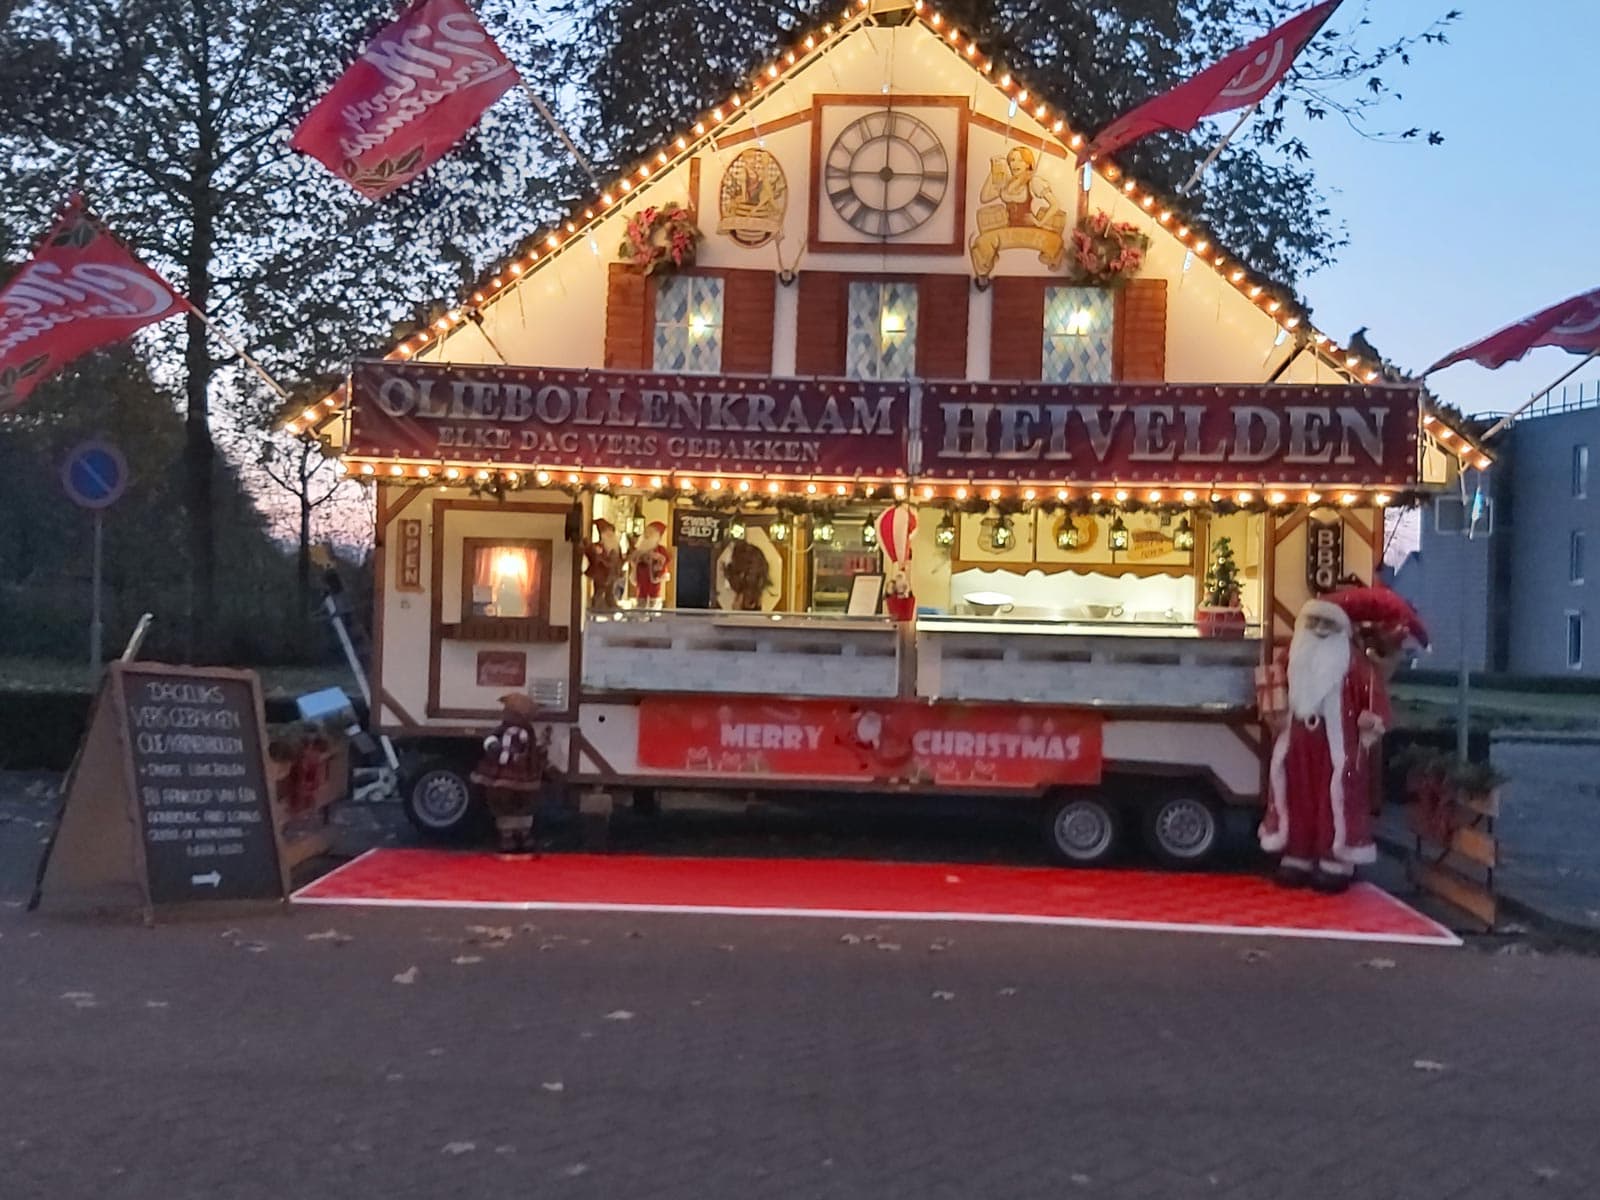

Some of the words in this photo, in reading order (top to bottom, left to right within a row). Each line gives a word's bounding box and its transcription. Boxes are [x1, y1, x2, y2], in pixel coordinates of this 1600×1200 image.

[379, 376, 896, 436] OLIEBOLLENKRAAM
[937, 402, 1390, 466] HEIVELDEN
[438, 425, 512, 450] ELKE
[588, 432, 658, 456] VERS
[666, 436, 821, 463] GEBAKKEN
[404, 522, 420, 585] OPEN
[719, 723, 825, 751] MERRY
[911, 729, 1081, 761] CHRISTMAS
